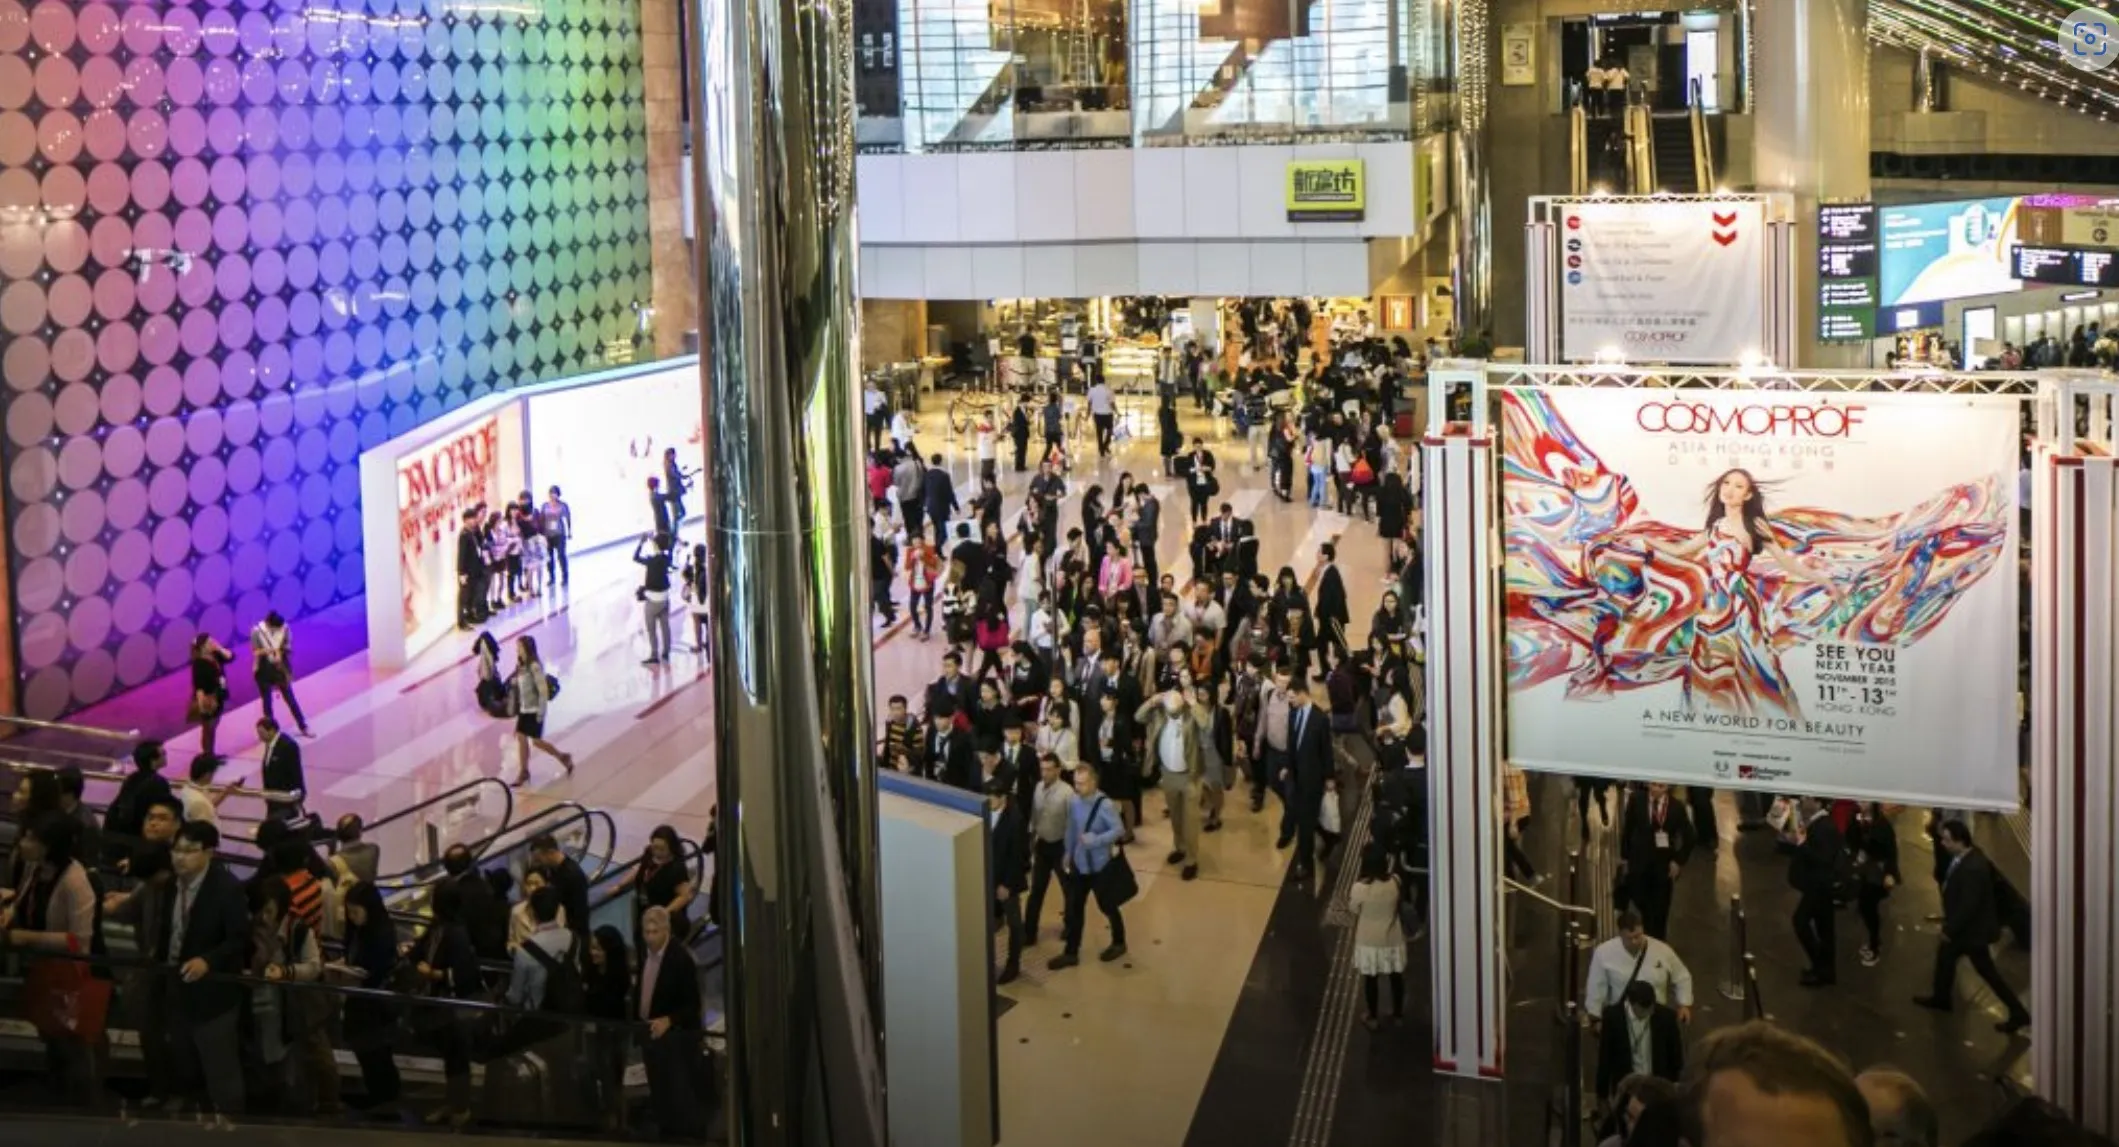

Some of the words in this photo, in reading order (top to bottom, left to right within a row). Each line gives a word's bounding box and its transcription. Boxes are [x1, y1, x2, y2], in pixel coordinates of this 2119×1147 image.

[1637, 402, 1867, 437] COSMOPROF
[1669, 441, 1707, 452] ASIA
[1716, 442, 1771, 455] HONG
[1779, 444, 1834, 457] KONG
[1816, 644, 1845, 659] SEE
[1856, 647, 1895, 662] YOU
[1816, 660, 1850, 670] NEXT
[1860, 663, 1895, 673] YEAR
[1815, 673, 1868, 683] NOVEMBER
[1816, 702, 1853, 713] HONG
[1860, 705, 1897, 716] KONG
[1643, 709, 1653, 720] A
[1660, 711, 1696, 723] NEW
[1704, 714, 1759, 728] WORLD
[1767, 719, 1797, 732] FOR
[1806, 723, 1865, 737] BEAUTY
